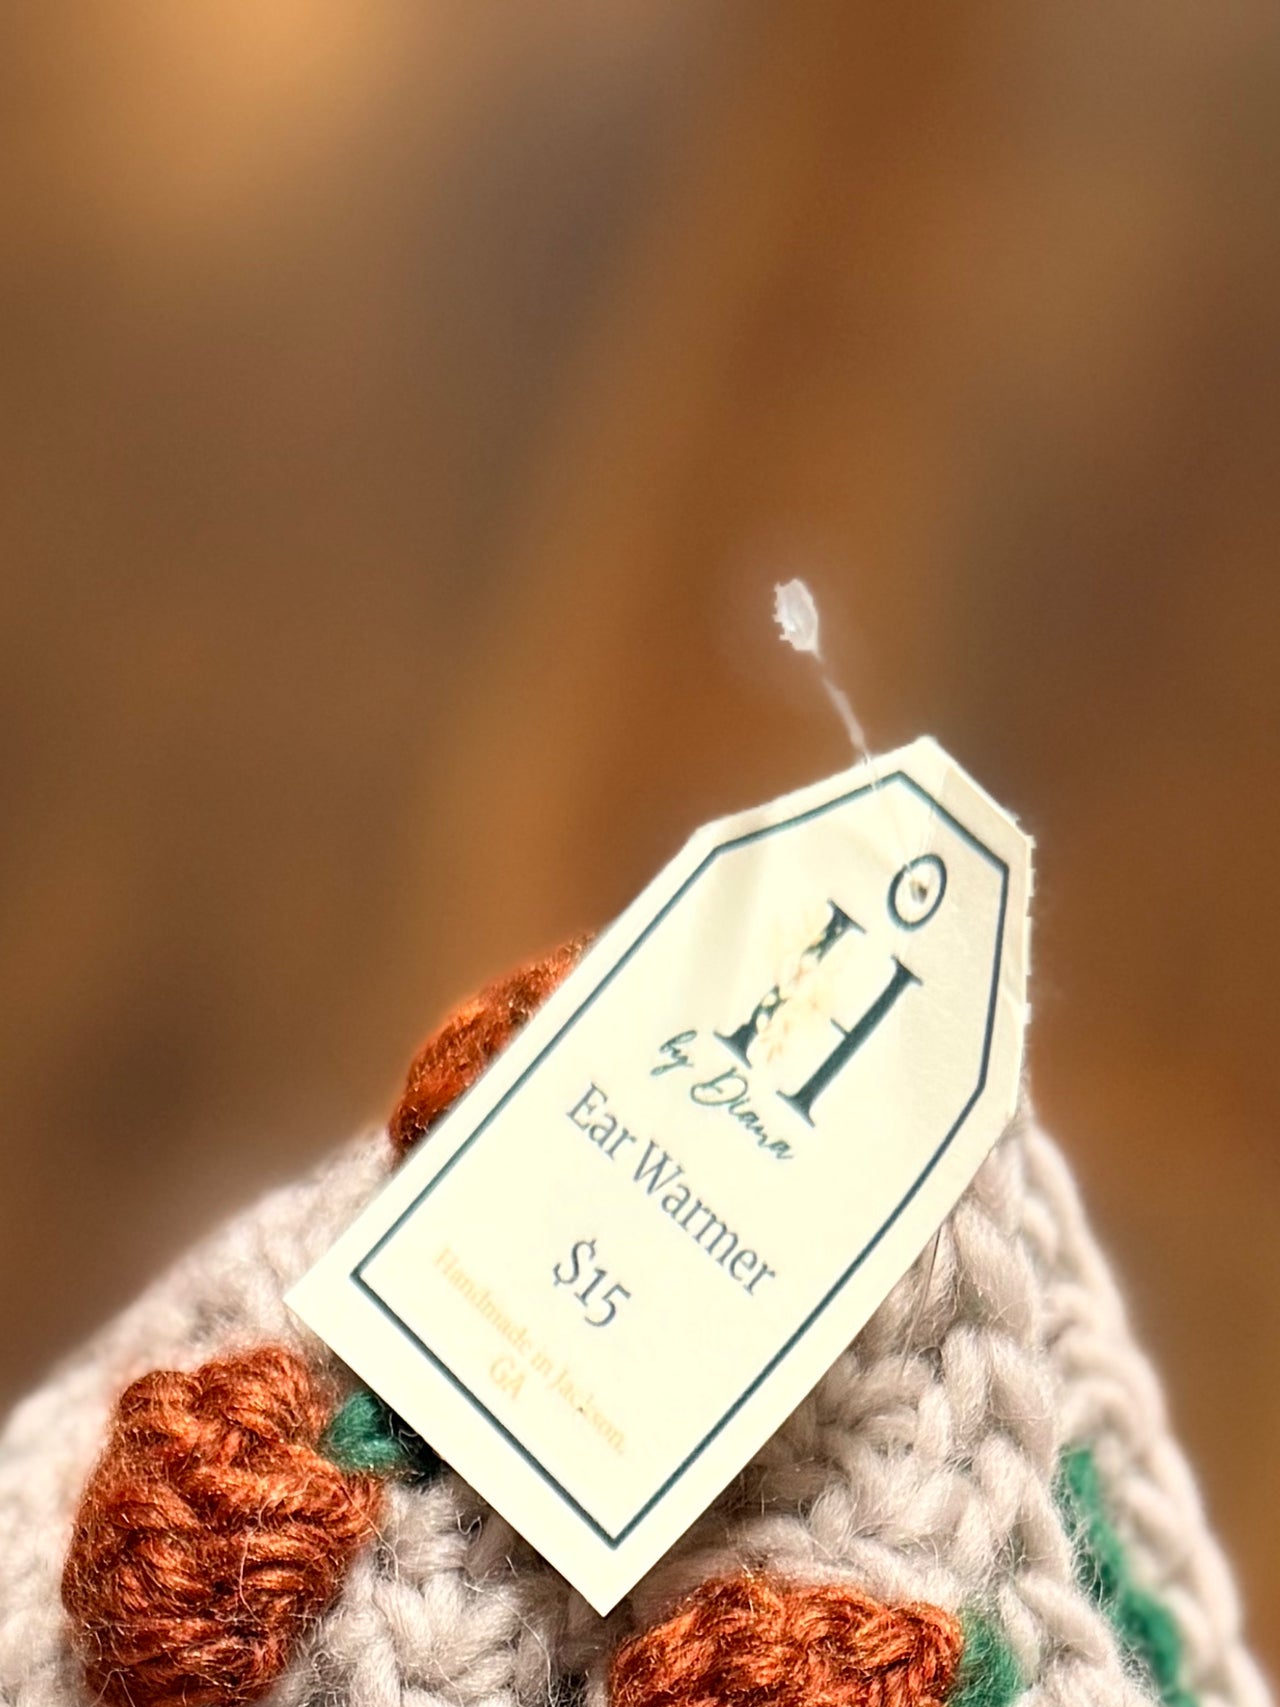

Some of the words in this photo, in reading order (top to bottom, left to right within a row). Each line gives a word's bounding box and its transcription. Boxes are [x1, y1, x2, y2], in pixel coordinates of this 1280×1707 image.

[650, 1030, 698, 1076] by
[690, 1066, 793, 1159] Diana
[566, 1082, 637, 1160] Ear
[633, 1140, 776, 1296] Warmer
[434, 1247, 532, 1355] Handmade
[530, 1349, 554, 1377] in
[552, 1238, 632, 1327] $15
[489, 1354, 527, 1402] GA
